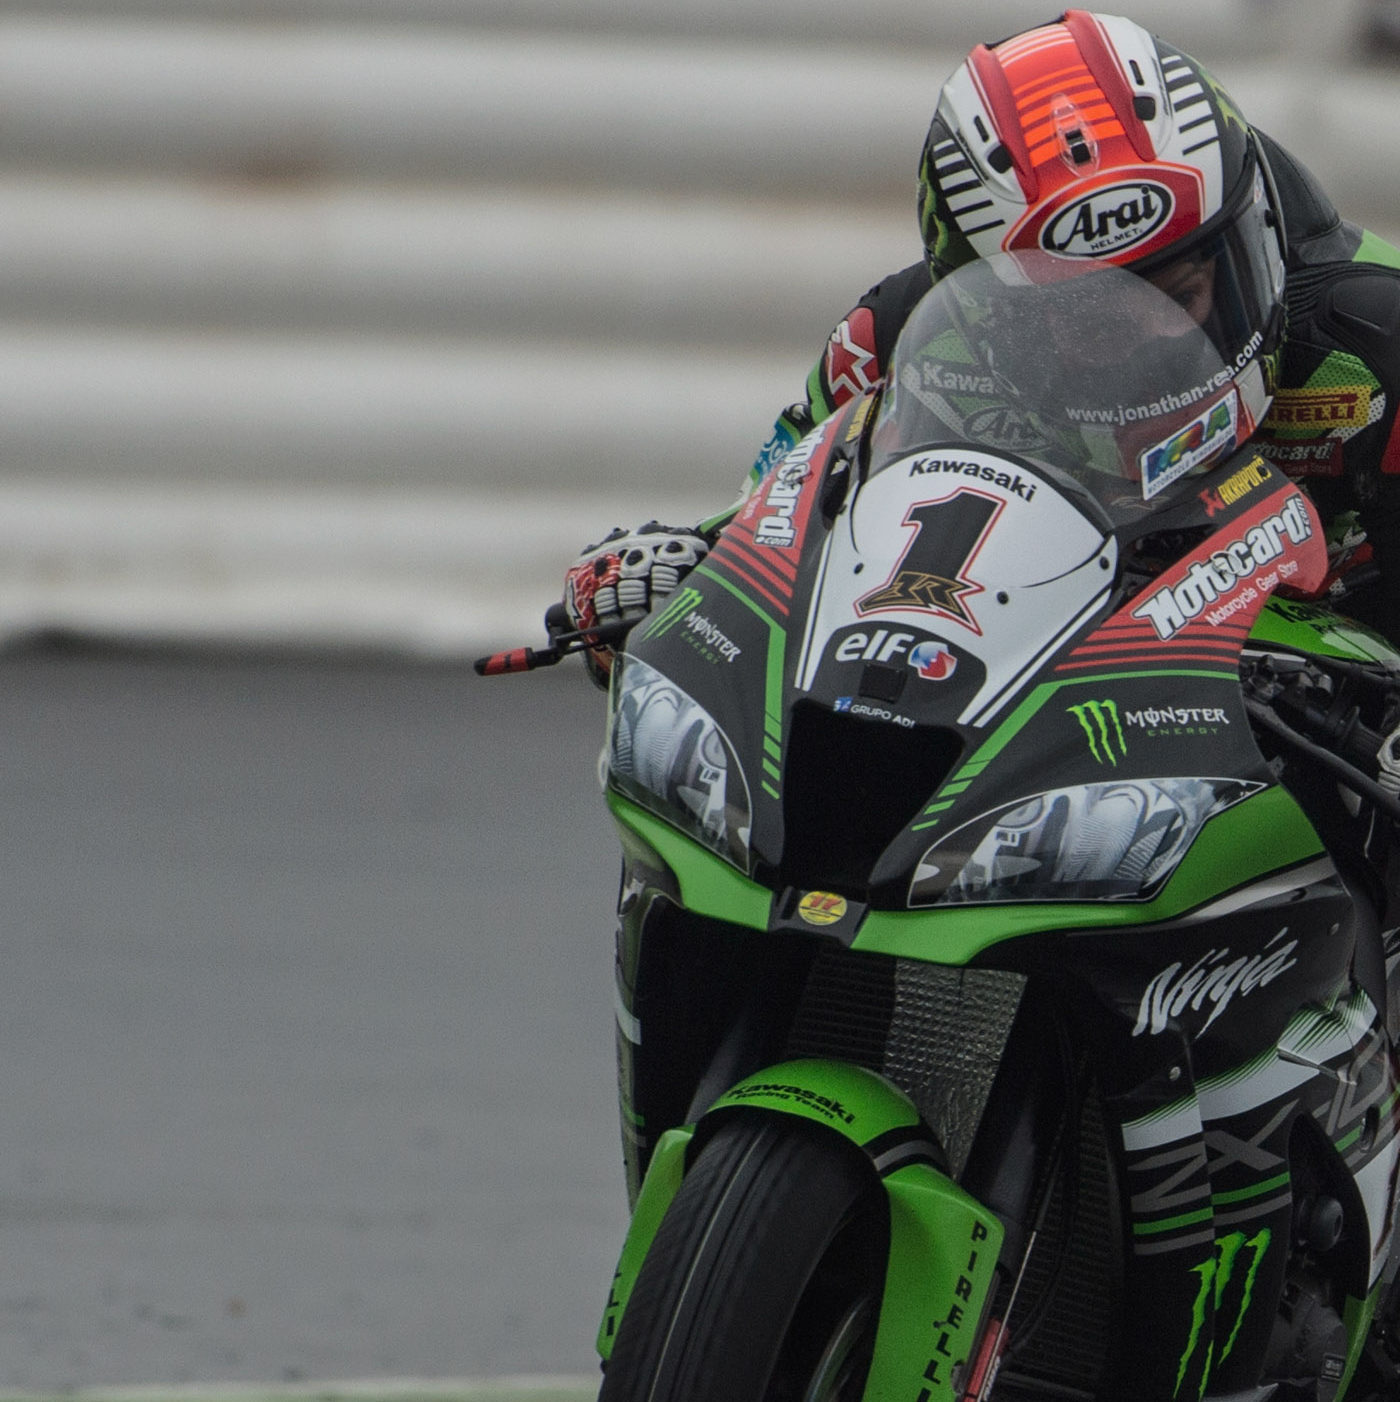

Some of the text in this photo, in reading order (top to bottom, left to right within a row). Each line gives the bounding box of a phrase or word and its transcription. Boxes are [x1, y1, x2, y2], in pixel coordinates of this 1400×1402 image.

[1057, 185, 1158, 251] Arai
[1090, 228, 1138, 251] HELMET
[1065, 330, 1264, 425] www.jonathan-rea.com
[909, 457, 1038, 502] Kawasaki
[853, 486, 1007, 637] 1
[1132, 496, 1307, 640] Motocard
[1204, 587, 1258, 626] Motorcycle
[1256, 572, 1280, 592] Gear
[1278, 560, 1298, 579] Store
[684, 611, 742, 662] MONSTER
[835, 629, 915, 662] elf
[850, 704, 892, 720] GRUPO
[1125, 706, 1230, 727] MONSTER
[1147, 727, 1218, 737] ENERGY
[1132, 926, 1298, 1040] Ninja
[727, 1084, 856, 1124] Kawasaki
[794, 1095, 835, 1119] Team
[916, 1220, 988, 1402] PIRELLI
